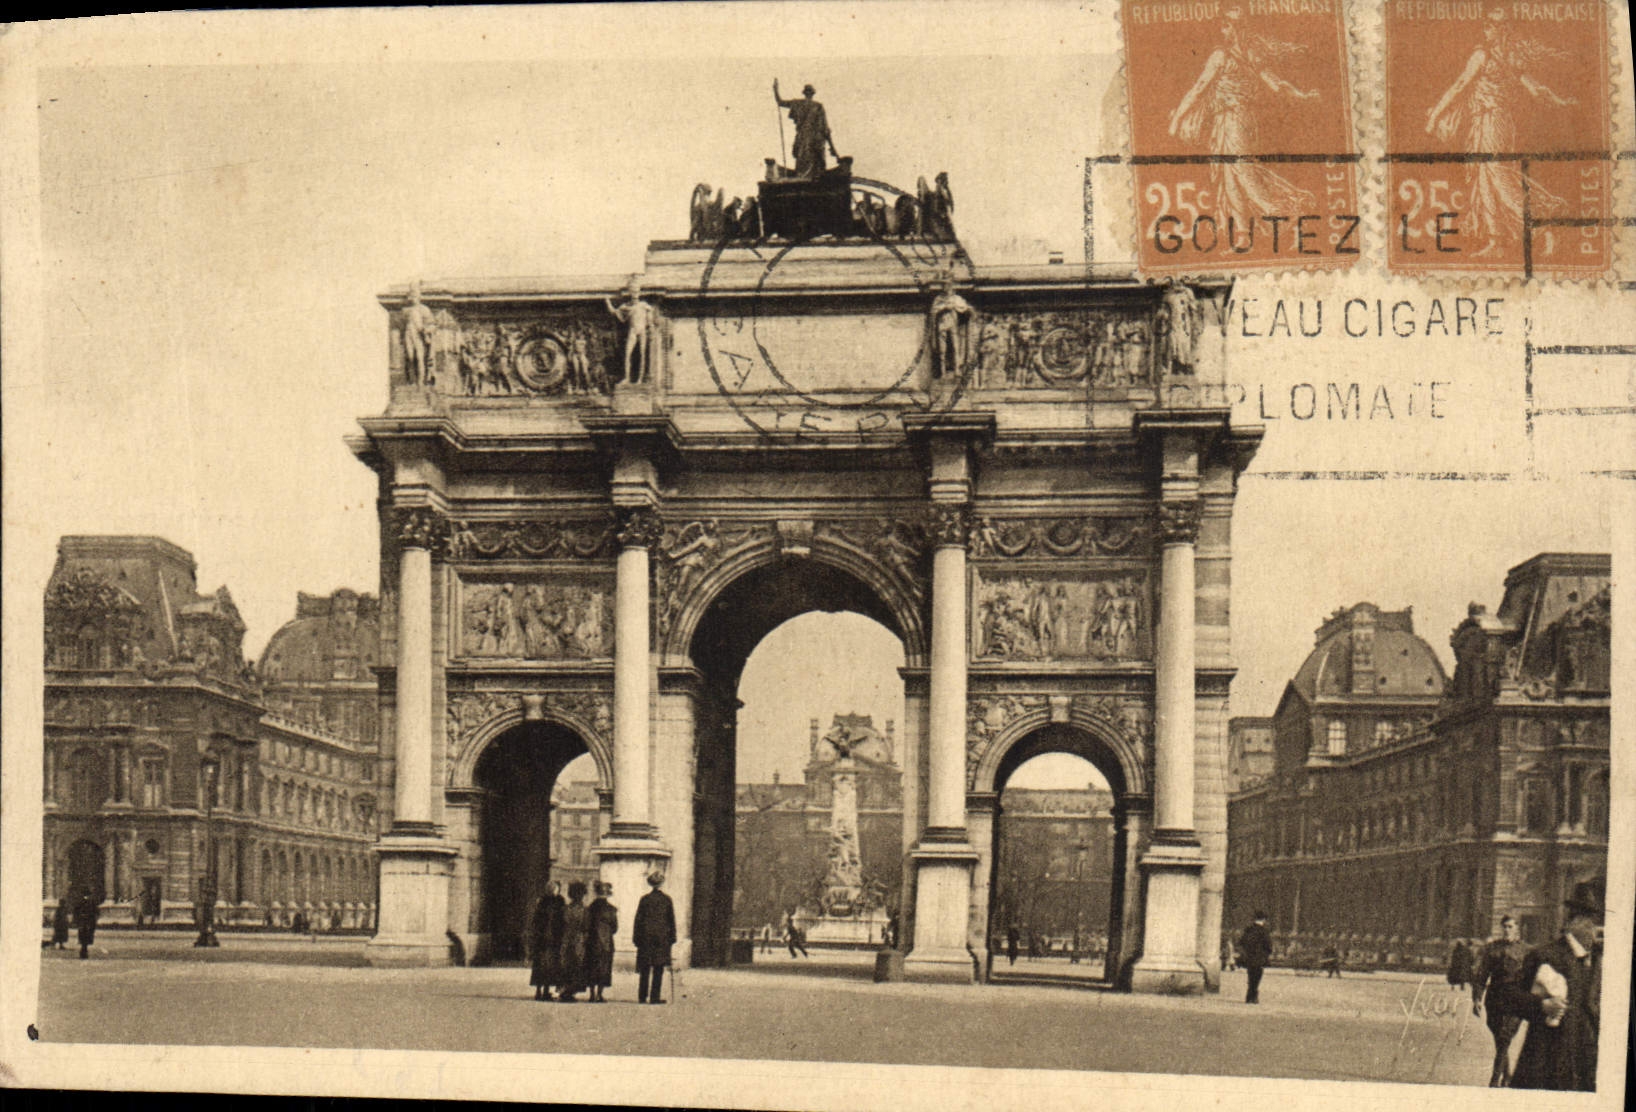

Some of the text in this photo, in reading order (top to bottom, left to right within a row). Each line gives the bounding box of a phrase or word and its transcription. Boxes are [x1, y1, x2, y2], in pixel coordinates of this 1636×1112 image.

[1153, 212, 1463, 255] GOUTEZ LE
[1344, 297, 1507, 338] CIGARE
